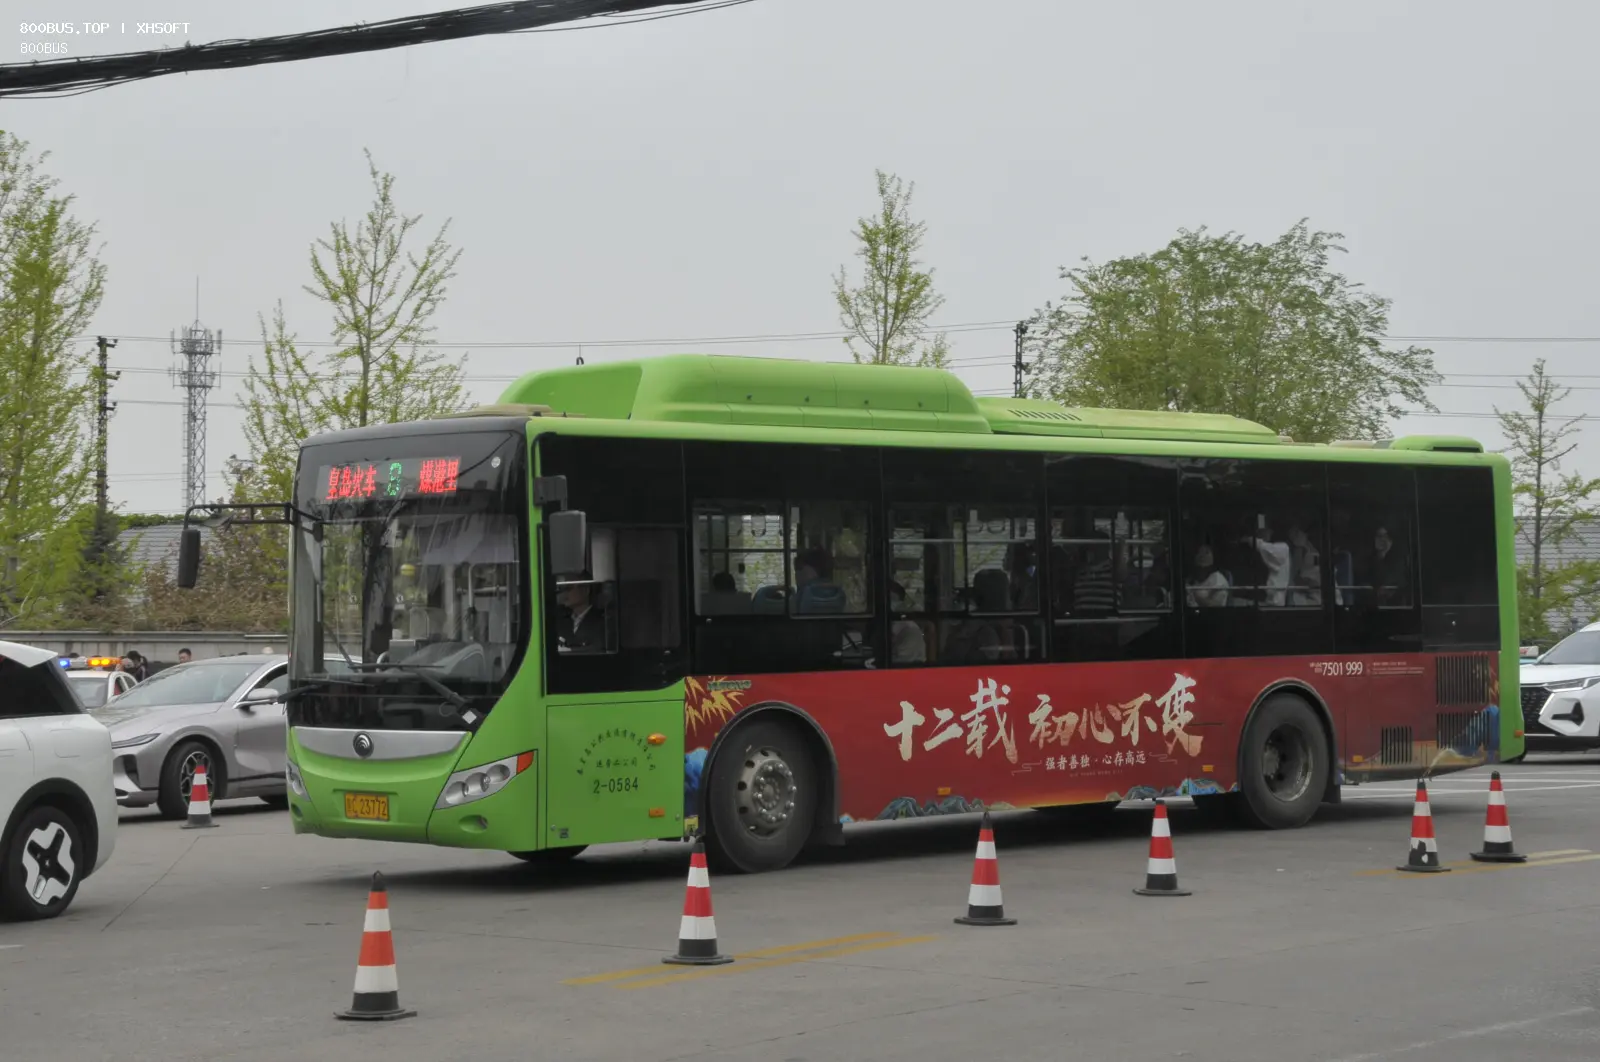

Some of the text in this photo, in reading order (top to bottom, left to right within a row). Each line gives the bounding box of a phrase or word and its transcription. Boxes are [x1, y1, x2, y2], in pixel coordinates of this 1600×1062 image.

[1322, 662, 1343, 676] 7501
[1345, 661, 1363, 676] 999
[883, 678, 1018, 764] 十二载
[593, 776, 638, 794] 2-0584
[360, 797, 387, 816] 23772
